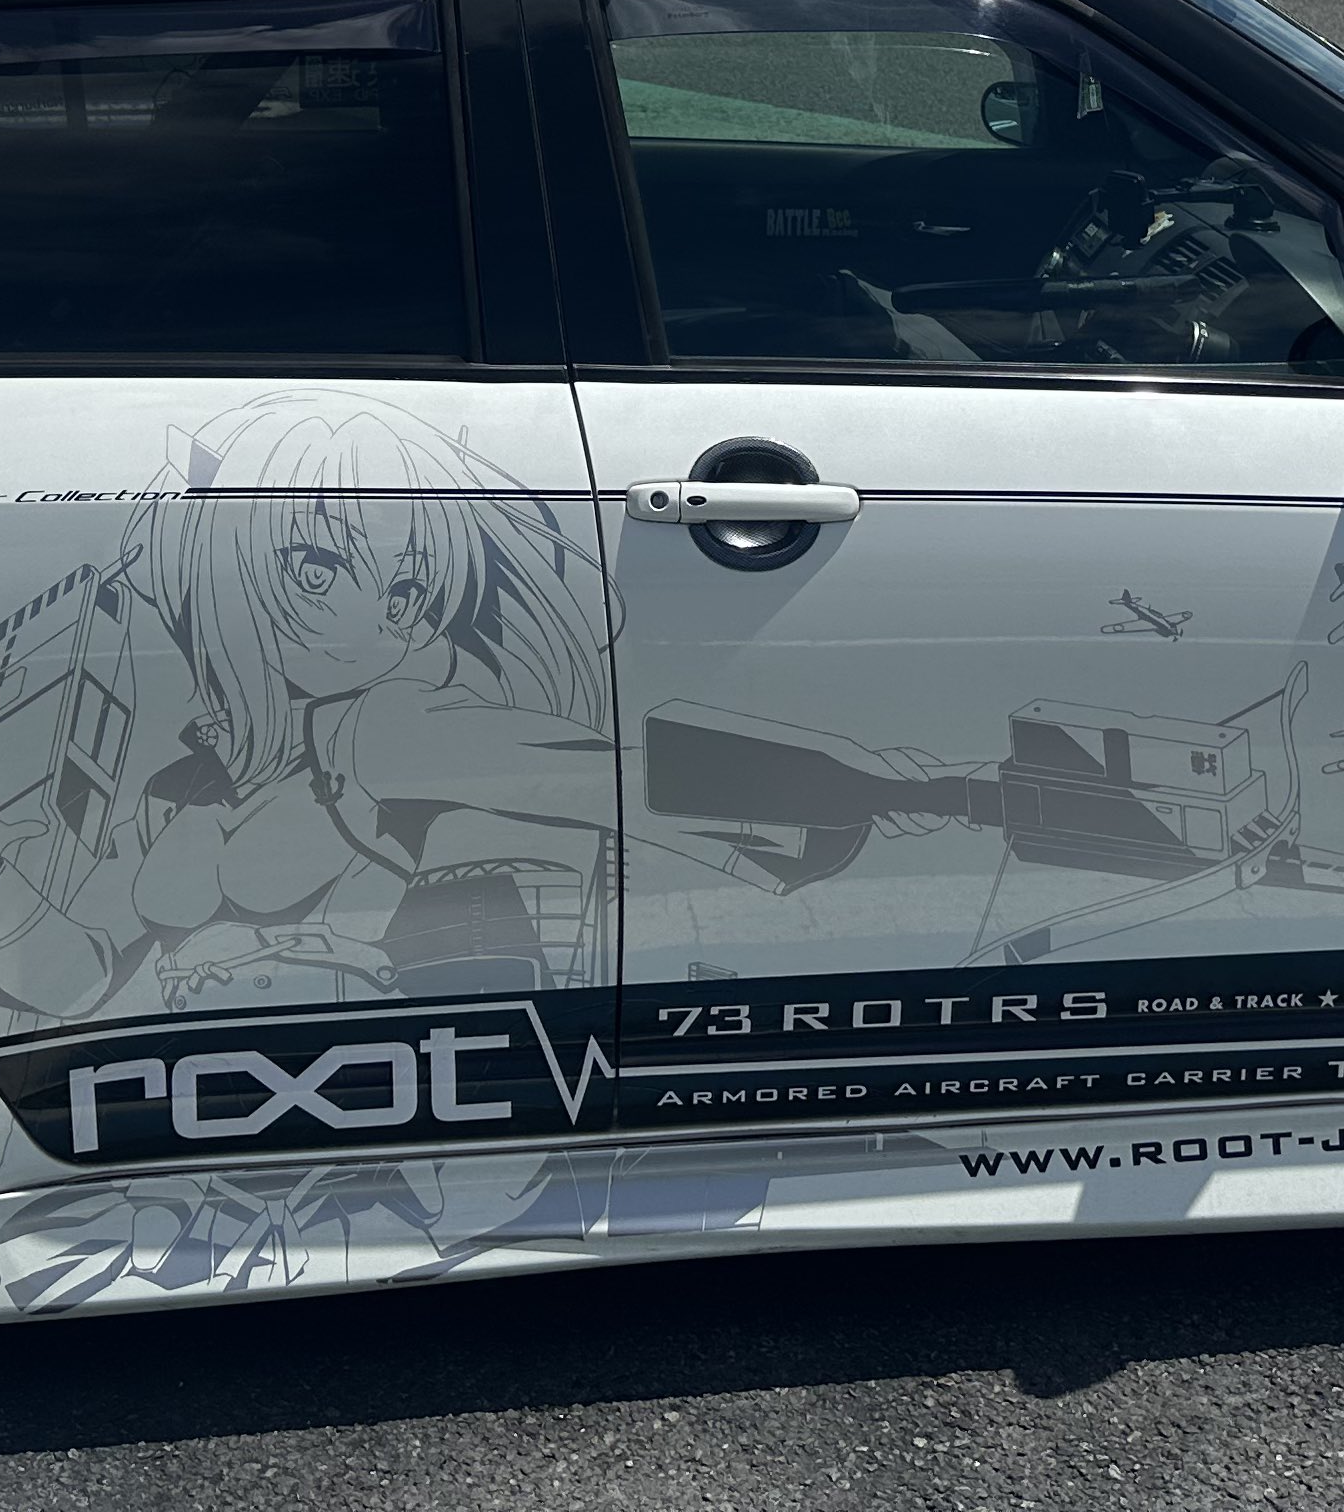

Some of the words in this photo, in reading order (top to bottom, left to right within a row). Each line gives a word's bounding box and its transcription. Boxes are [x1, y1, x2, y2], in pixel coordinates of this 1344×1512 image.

[766, 208, 821, 237] BATTLE
[15, 490, 182, 503] Collection
[1137, 996, 1199, 1013] ROAD
[1209, 996, 1225, 1010] &
[1235, 993, 1304, 1009] TRACK
[658, 1003, 751, 1037] 73
[656, 1084, 868, 1107] ARMORED
[894, 1074, 1101, 1096] AIRCRAFT
[1126, 1065, 1303, 1087] CARRIER
